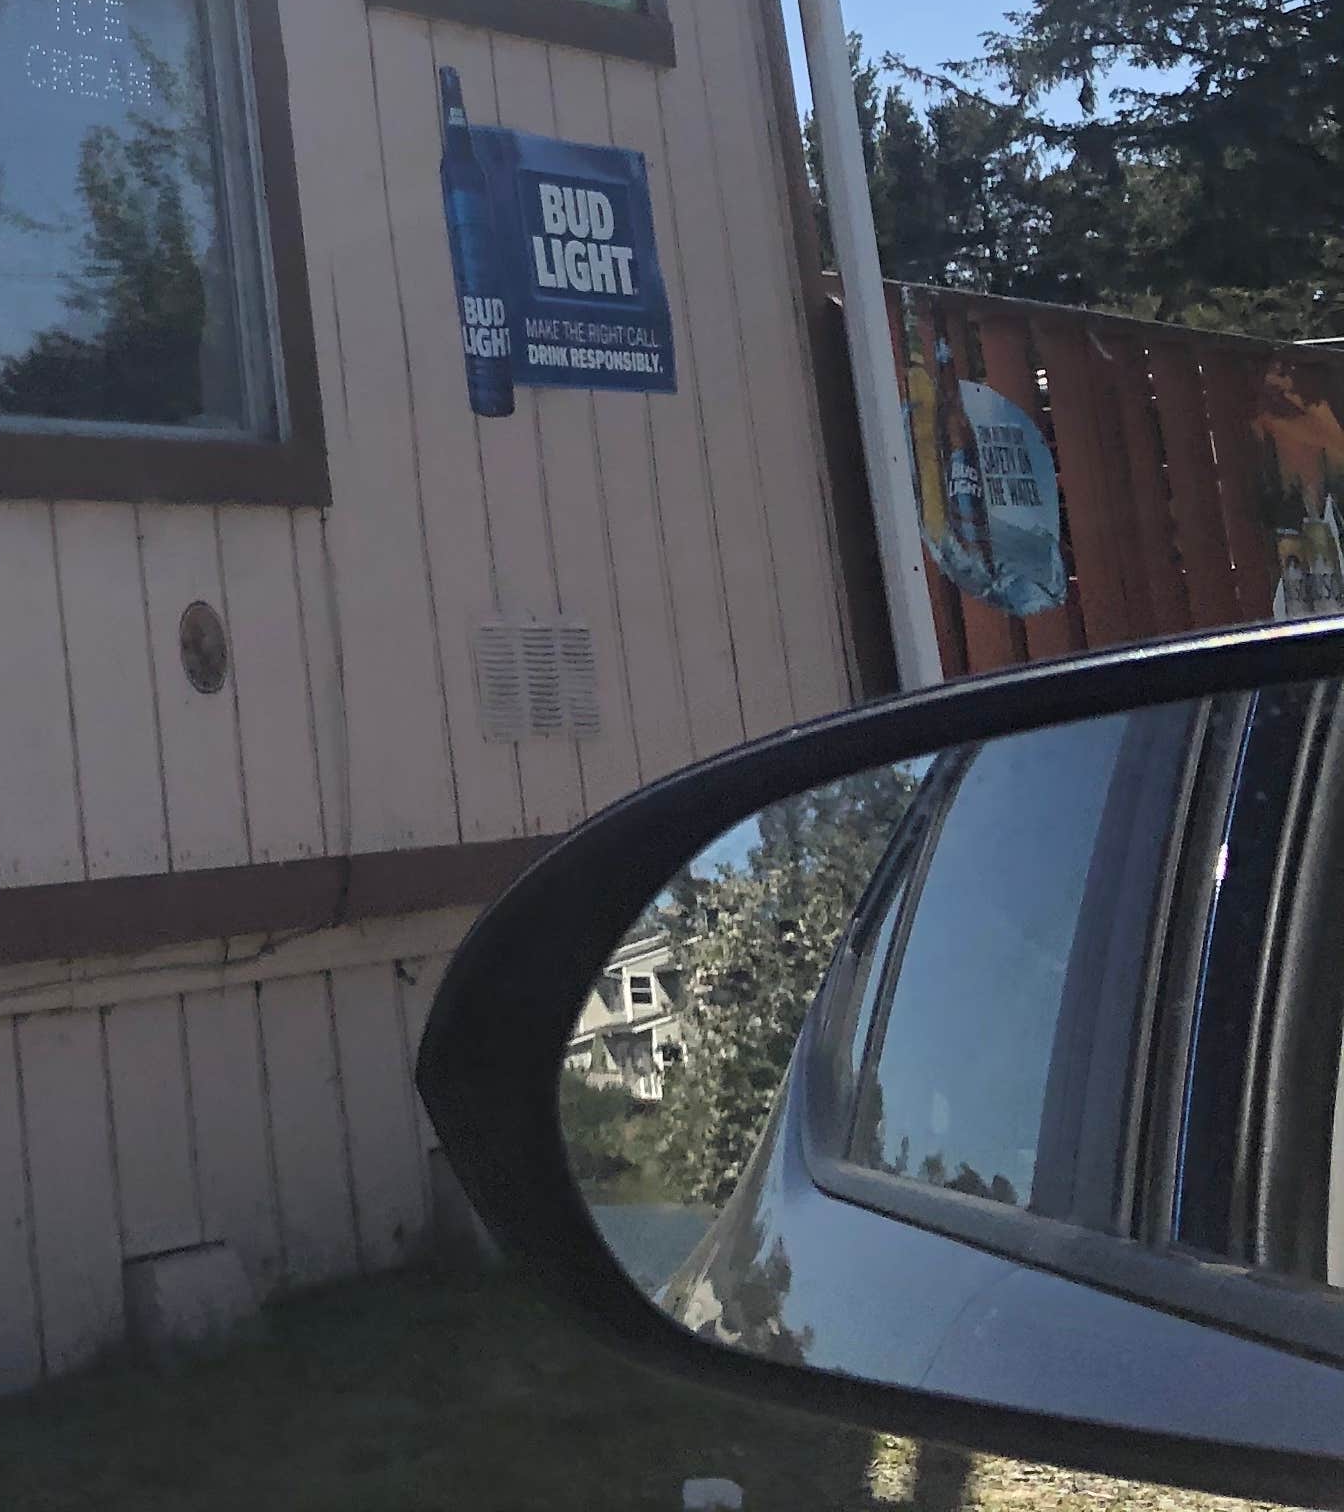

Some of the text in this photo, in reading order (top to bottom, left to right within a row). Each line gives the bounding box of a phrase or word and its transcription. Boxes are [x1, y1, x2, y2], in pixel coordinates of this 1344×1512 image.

[538, 183, 615, 240] BUD
[532, 235, 634, 296] LIGHT
[463, 295, 505, 327] BUD
[525, 317, 560, 340] MAKE
[561, 320, 586, 343] THE
[587, 322, 625, 346] RIGHT
[528, 343, 569, 366] DRINK
